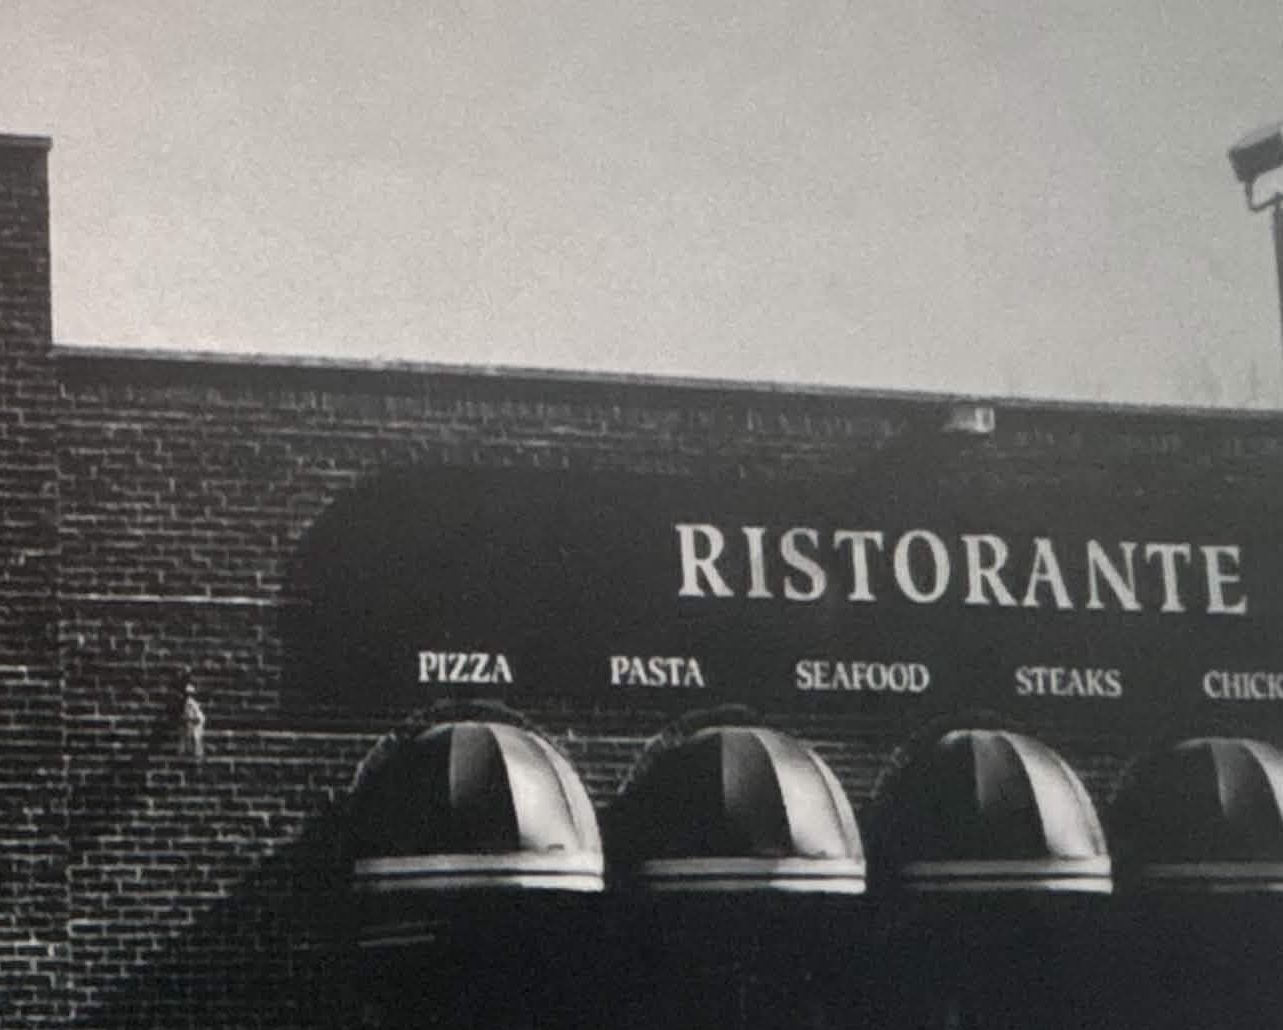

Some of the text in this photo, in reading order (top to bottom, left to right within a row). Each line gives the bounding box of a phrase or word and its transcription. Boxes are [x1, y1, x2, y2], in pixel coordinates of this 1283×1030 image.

[674, 522, 1249, 615] RISTORANTE
[417, 650, 514, 684] PIZZA
[609, 655, 706, 688] PASTA
[795, 658, 931, 694] SEAFOOD
[1014, 665, 1124, 699] STEAKS
